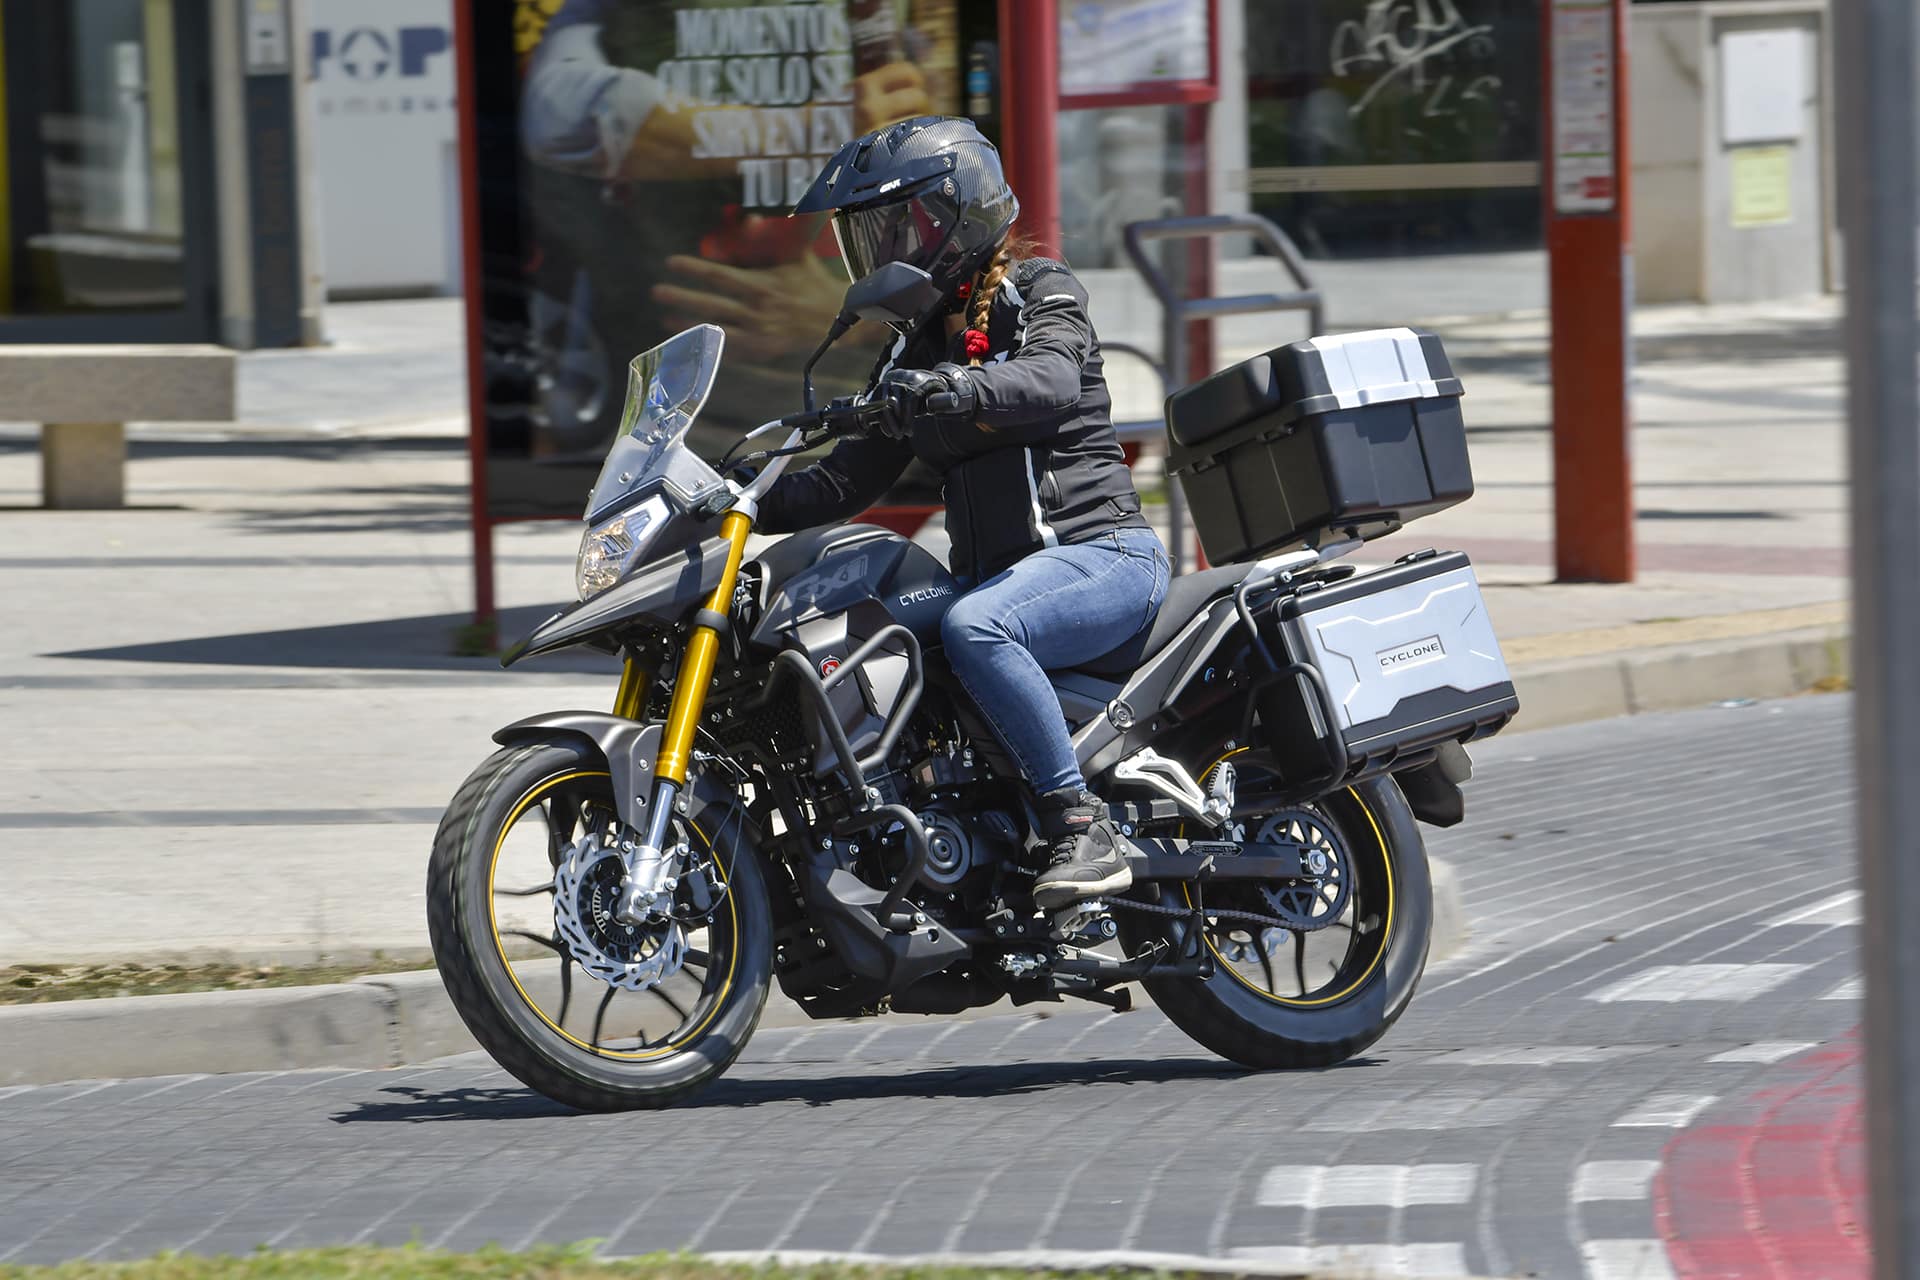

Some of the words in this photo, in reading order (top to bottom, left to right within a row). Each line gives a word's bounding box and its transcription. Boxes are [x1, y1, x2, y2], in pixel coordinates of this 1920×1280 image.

[675, 6, 851, 58] MOMENTOS
[656, 60, 722, 113] QUE
[725, 56, 811, 106] SOLO
[812, 54, 854, 103] SE
[811, 105, 854, 155] EN
[737, 159, 785, 208] TU
[899, 585, 952, 607] CYCLONE
[1380, 643, 1439, 666] CYCLONE
